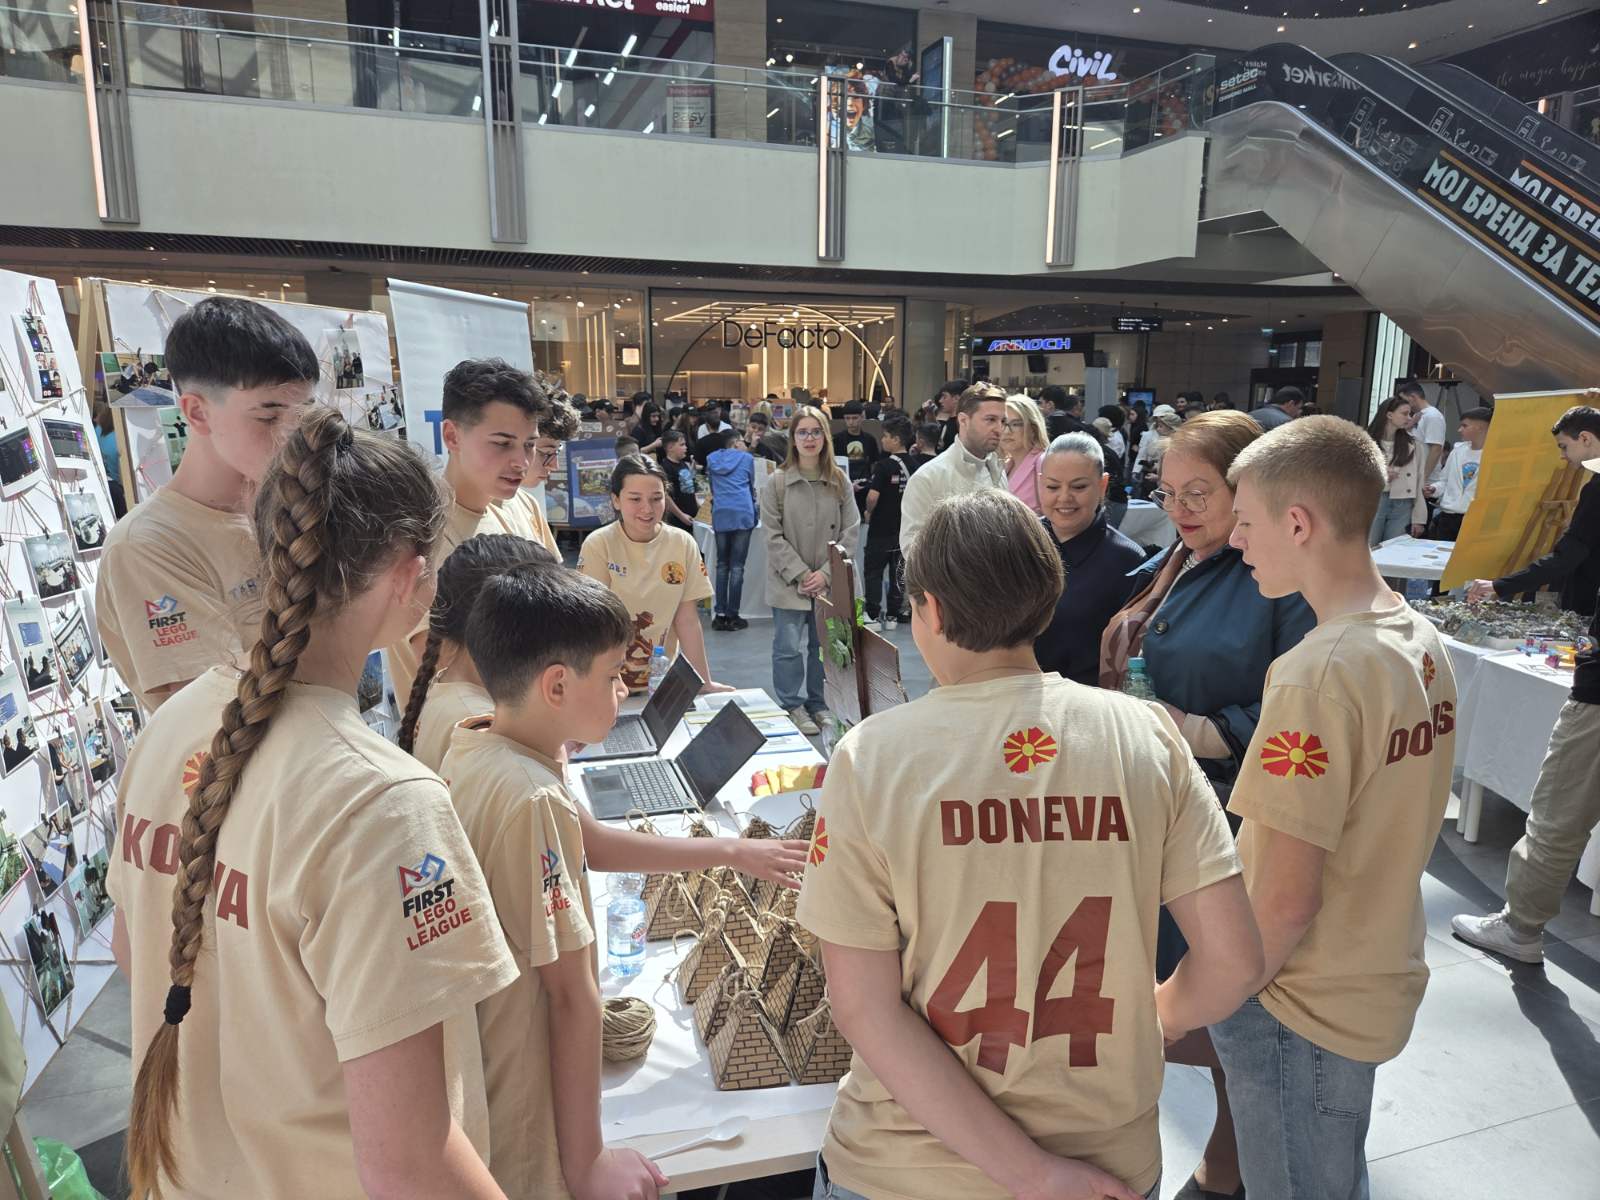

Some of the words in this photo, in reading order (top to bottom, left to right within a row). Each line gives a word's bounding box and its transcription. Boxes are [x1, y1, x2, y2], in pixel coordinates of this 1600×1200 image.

[1462, 184, 1540, 257] БРЕНД
[1532, 233, 1568, 275] ЗА
[723, 320, 842, 349] DeFacto
[149, 611, 186, 629] FIRST
[155, 623, 188, 637] LEGO
[153, 630, 198, 648] LEAGUE
[940, 796, 1130, 846] DONEVA
[403, 879, 455, 918] FIRST
[413, 898, 456, 929] LEGO
[406, 907, 472, 951] LEAGUE
[927, 896, 1115, 1075] 44
